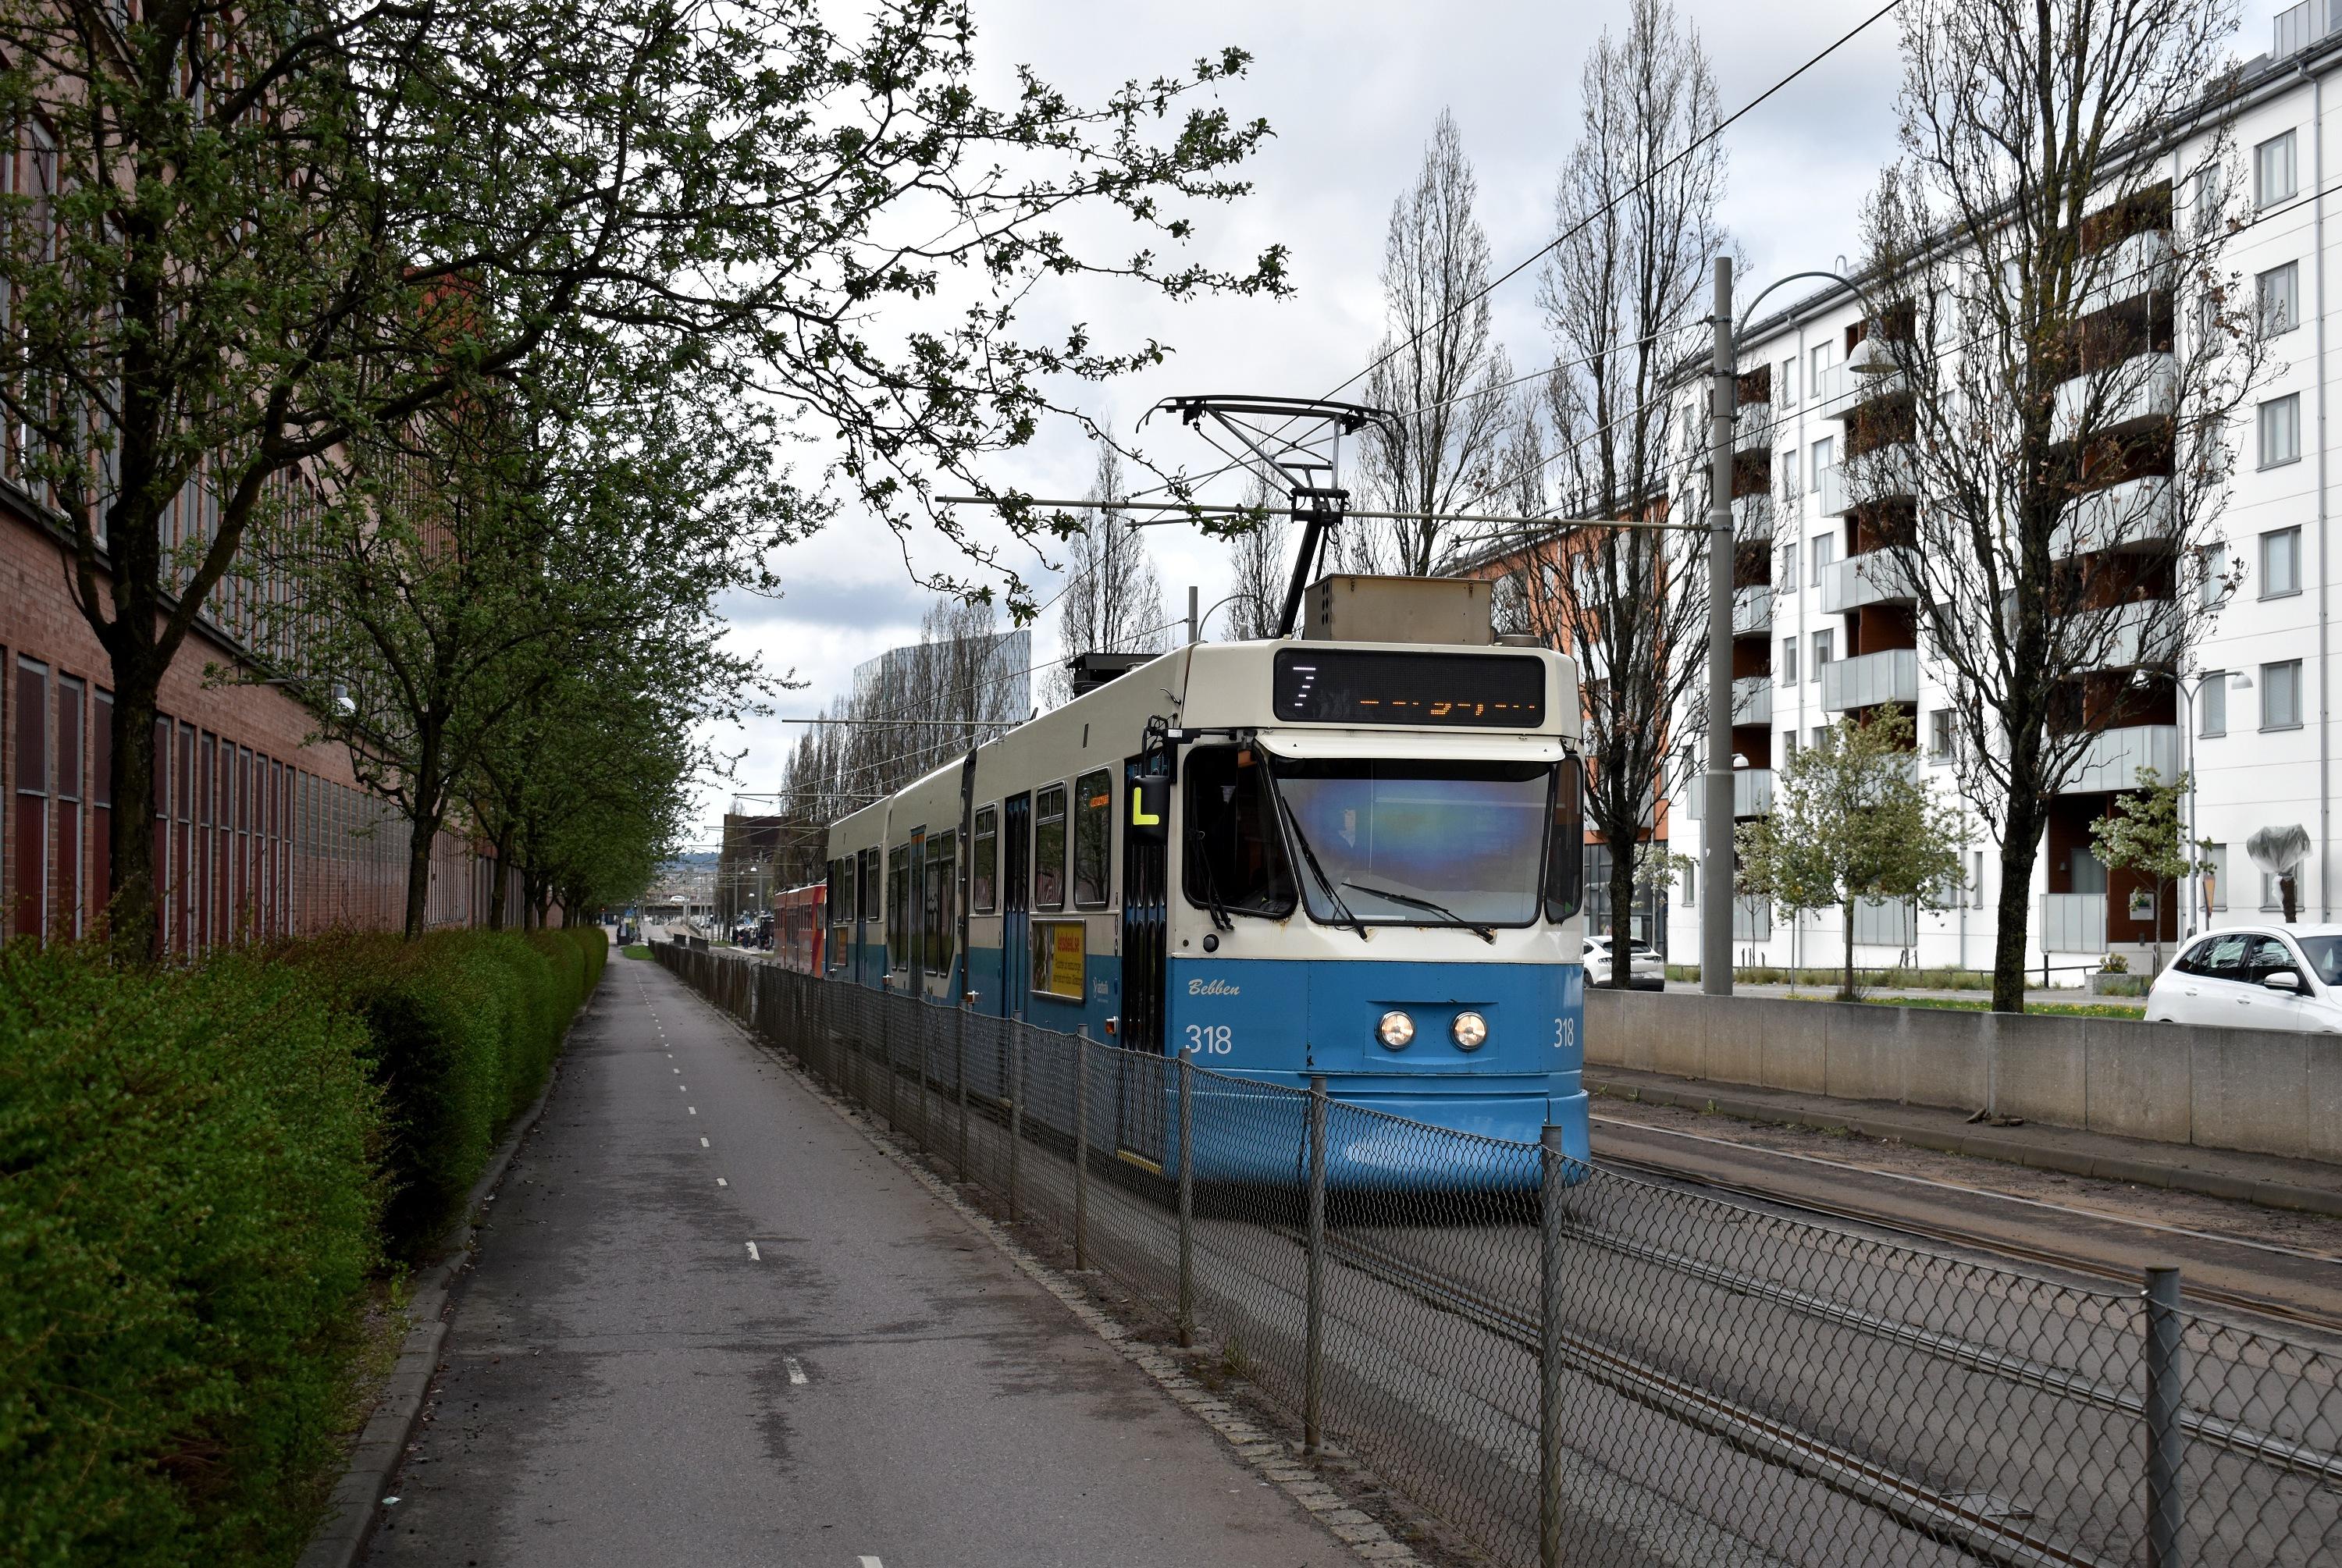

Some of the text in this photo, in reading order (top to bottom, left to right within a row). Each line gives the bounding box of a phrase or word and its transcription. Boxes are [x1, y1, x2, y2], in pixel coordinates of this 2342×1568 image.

[1188, 979, 1240, 995] Bebben
[1185, 1024, 1232, 1054] 318
[1554, 1017, 1574, 1047] 318
